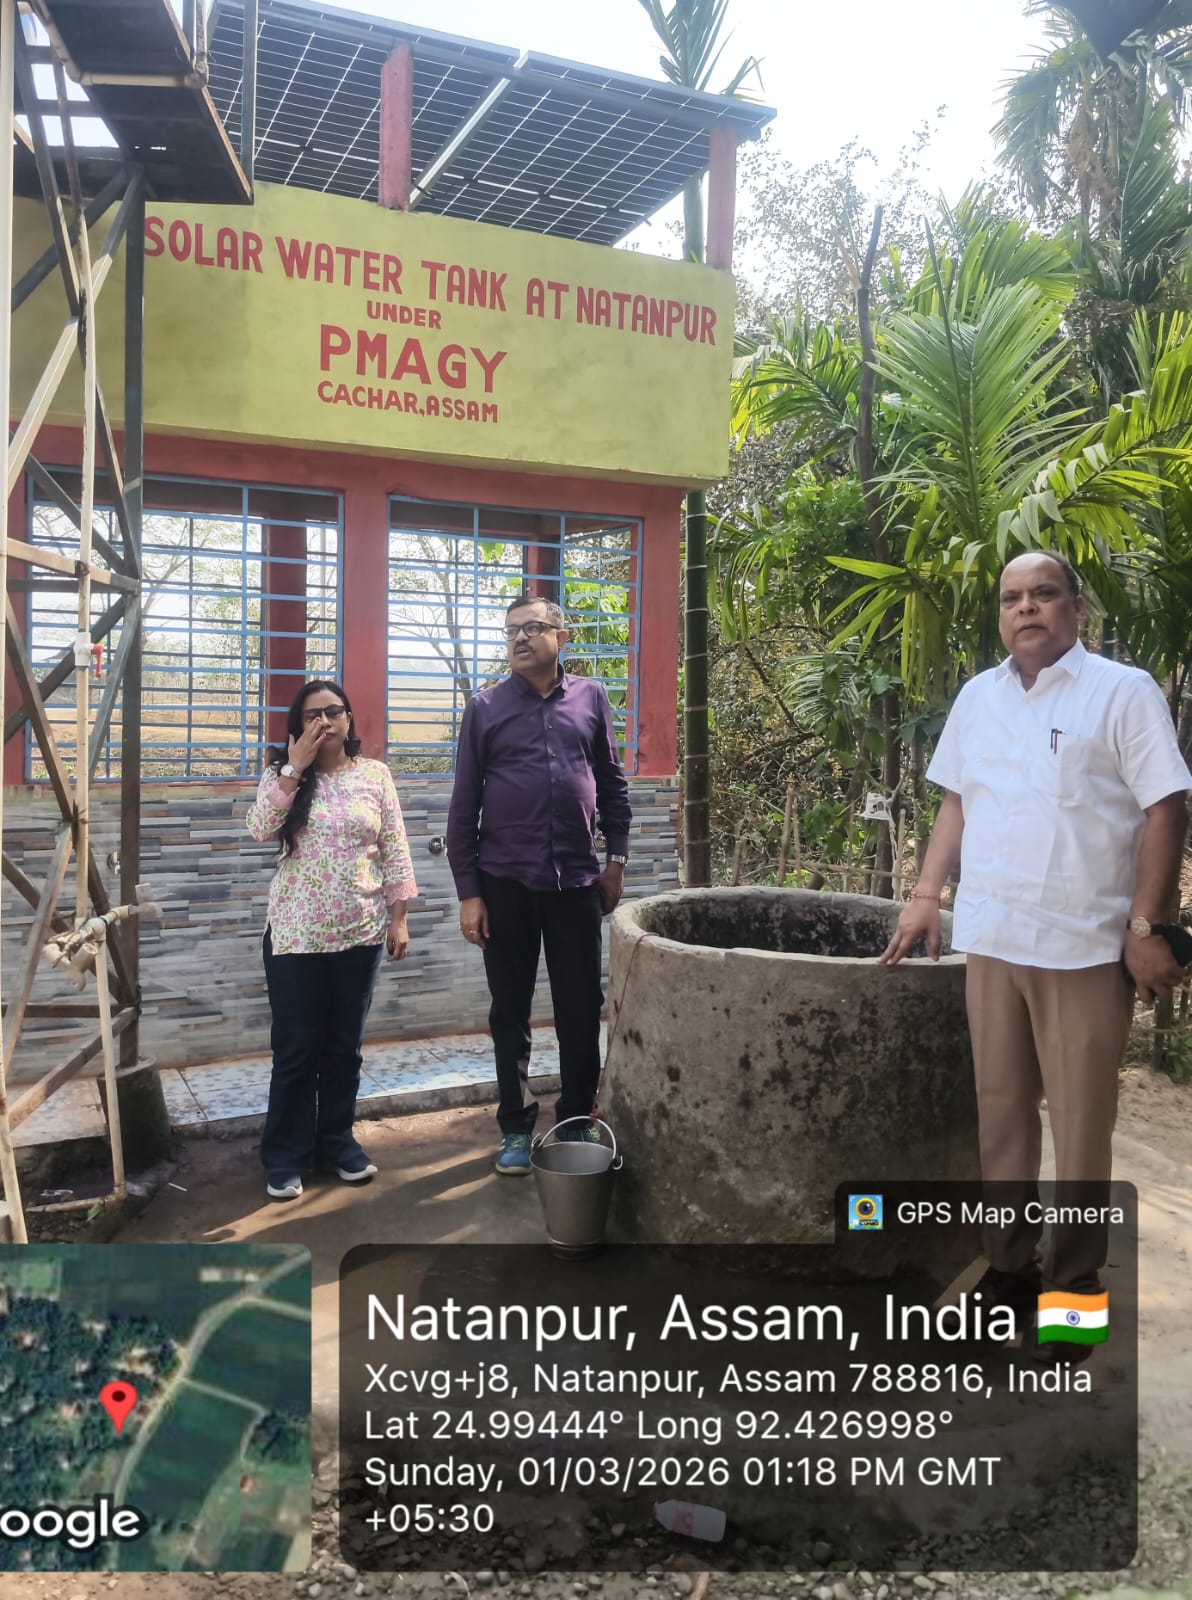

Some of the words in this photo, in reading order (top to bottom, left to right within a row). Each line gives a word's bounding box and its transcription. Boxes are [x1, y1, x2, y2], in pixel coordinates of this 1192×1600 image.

[144, 215, 264, 274] SOLAR
[274, 235, 404, 295] WATER
[420, 260, 509, 312] TANK
[526, 277, 570, 320] AT
[576, 286, 718, 346] NATANPUR
[366, 300, 443, 330] UNDER
[319, 323, 509, 394] PMAGY
